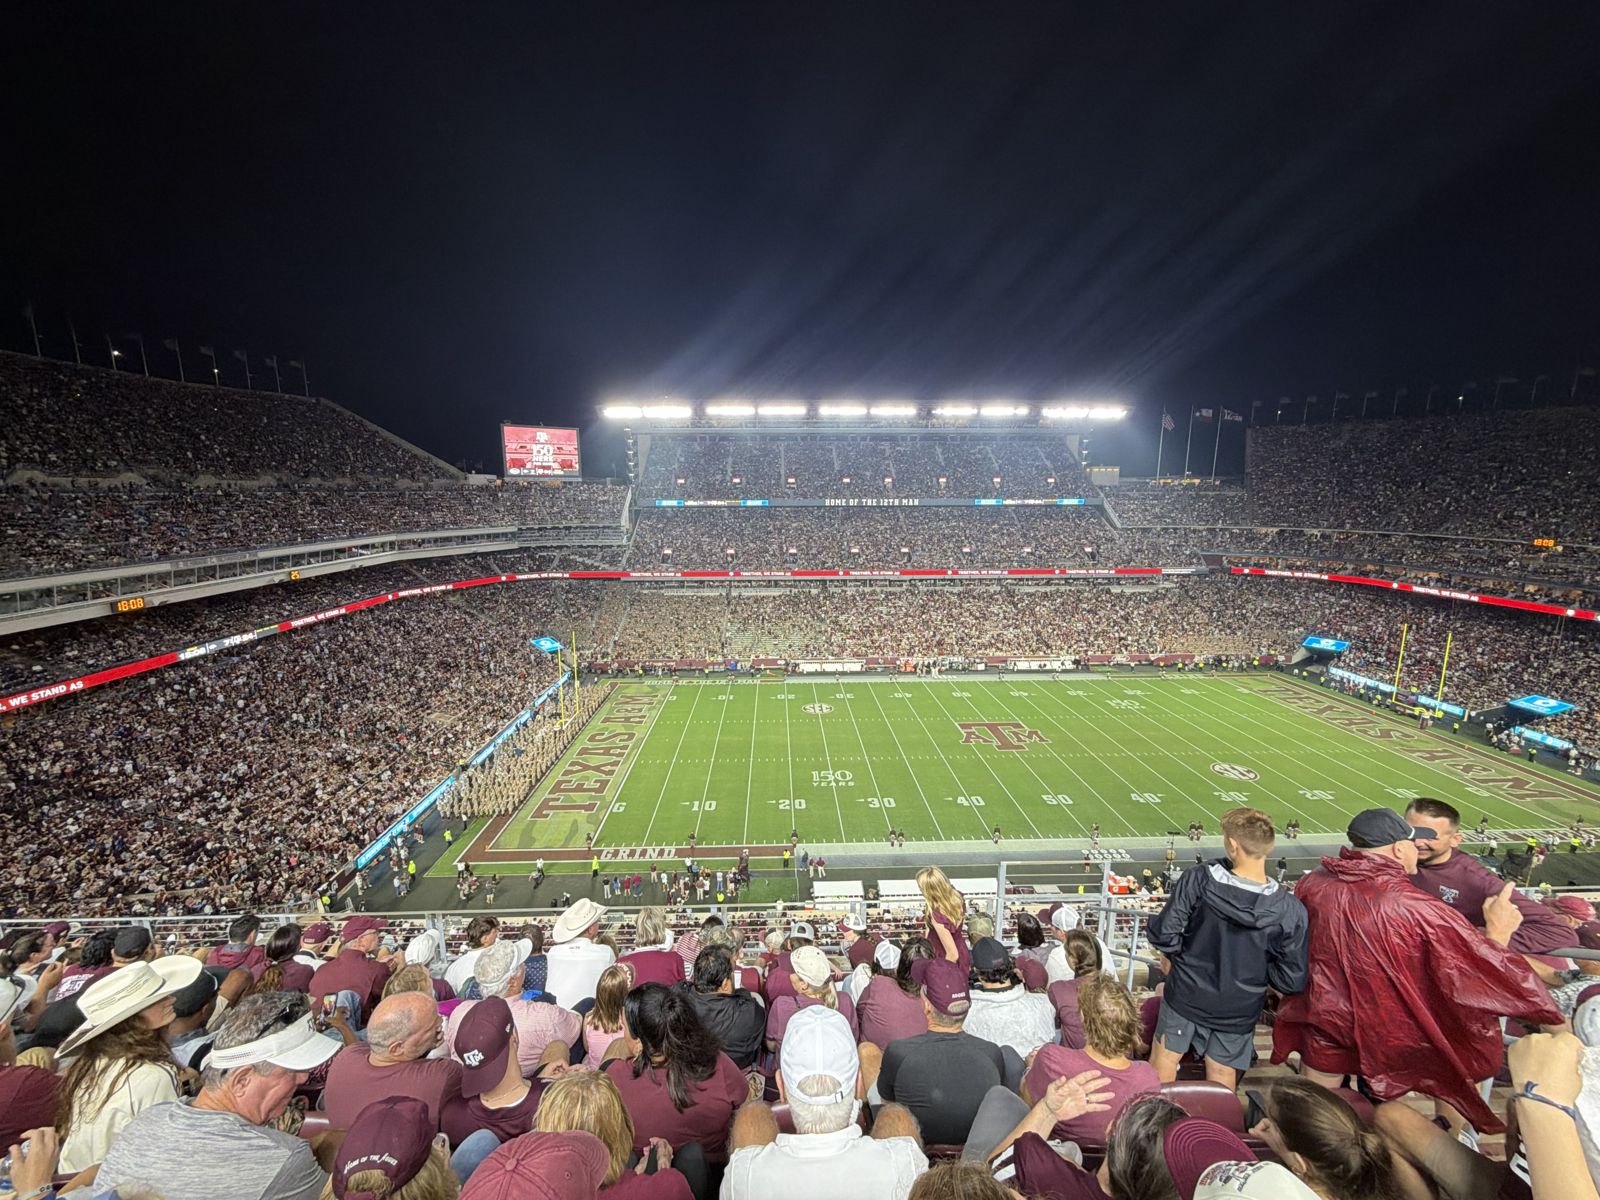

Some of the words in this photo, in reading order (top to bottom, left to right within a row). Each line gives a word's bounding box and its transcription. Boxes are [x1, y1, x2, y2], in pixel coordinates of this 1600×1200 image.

[825, 498, 847, 506] HOME
[849, 498, 859, 506] OF
[862, 498, 877, 506] THE
[879, 498, 899, 506] 12TH
[902, 498, 919, 506] MAN
[117, 598, 144, 611] 18:08
[8, 695, 29, 707] WE
[31, 684, 67, 701] STAND
[69, 680, 84, 691] AS
[804, 703, 832, 714] SEC
[1256, 685, 1418, 741] TEXAS
[1400, 746, 1578, 801] A&M
[528, 731, 638, 821] TEXAS
[600, 693, 661, 725] A&M
[811, 770, 853, 781] 150
[1041, 794, 1074, 805] 50
[1130, 792, 1162, 803] 40
[1212, 791, 1248, 801] 30
[1297, 789, 1333, 800] 20
[691, 800, 717, 811] 10
[778, 799, 806, 810] 20
[867, 797, 896, 808] 30
[956, 795, 986, 806] 40
[612, 802, 627, 812] G
